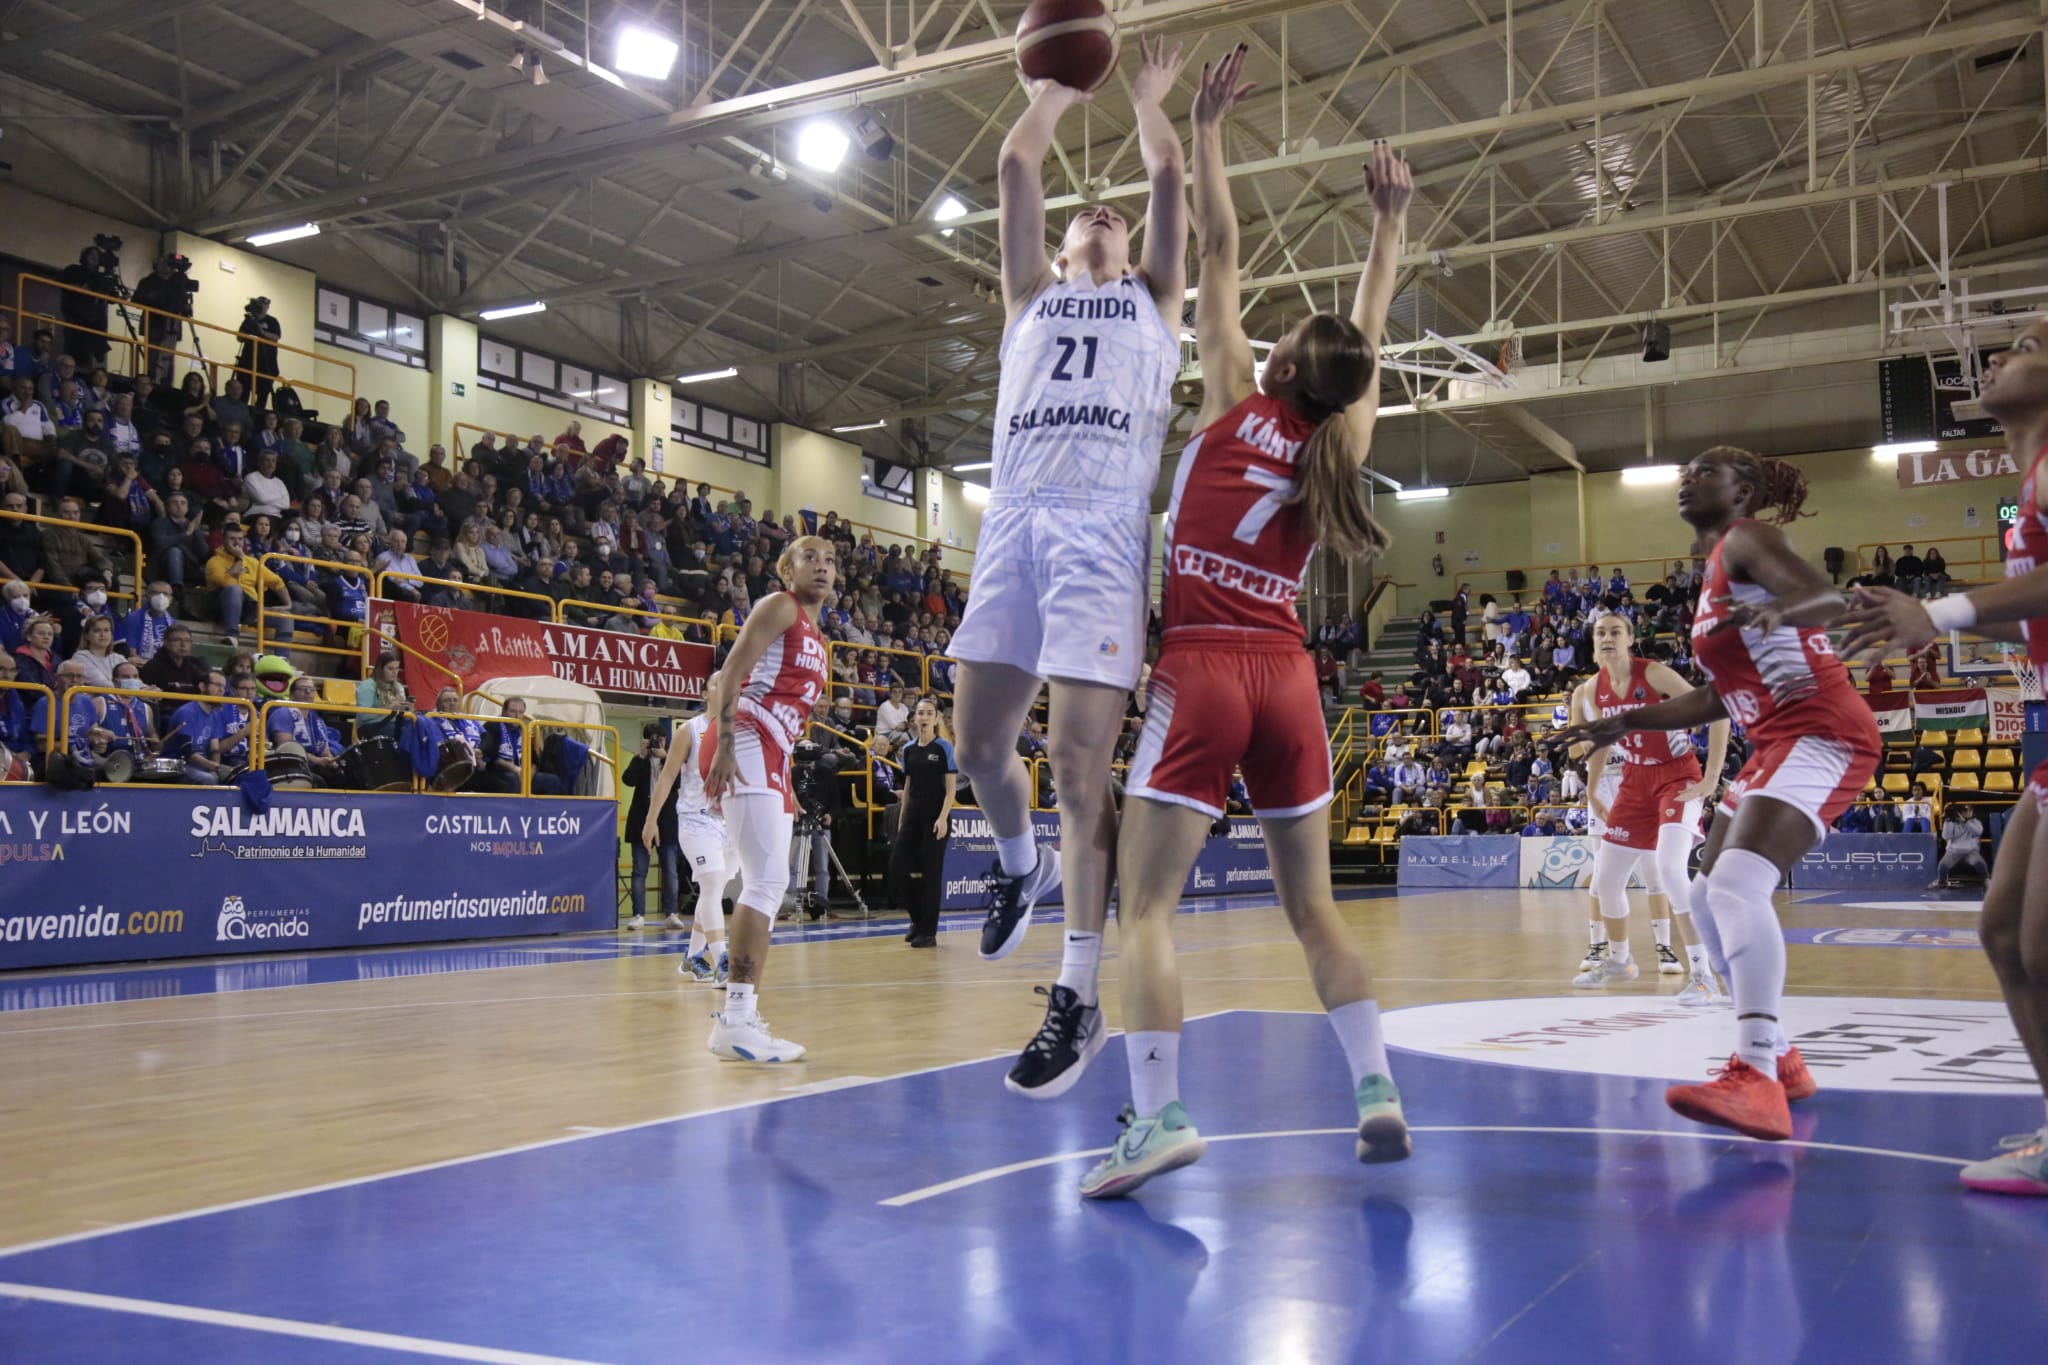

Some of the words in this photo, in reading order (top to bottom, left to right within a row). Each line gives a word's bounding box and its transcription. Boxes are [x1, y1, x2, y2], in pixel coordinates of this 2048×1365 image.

[1034, 297, 1137, 322] AVENIDA
[1050, 336, 1098, 381] 21
[1008, 405, 1131, 435] SALAMANCA
[1235, 412, 1304, 463] KÁNY
[1941, 428, 1966, 438] FALTAS
[1910, 452, 1960, 485] LA
[1965, 448, 2021, 478] GA
[1232, 464, 1298, 545] 7
[491, 627, 546, 659] Ranita
[542, 628, 682, 670] AMANCA
[582, 664, 604, 686] LA
[1935, 705, 1966, 715] MISKOLC
[1995, 718, 2027, 732] DIÓS
[28, 810, 49, 840] Y
[61, 802, 131, 834] LEÓN
[190, 805, 367, 838] SALAMANCA
[425, 814, 512, 835] CASTILLA
[520, 816, 532, 838] Y
[538, 810, 580, 835] LEÓN
[950, 818, 994, 838] SALAMA
[0, 843, 65, 866] PULSA
[238, 845, 290, 858] Patrimonio
[292, 845, 304, 857] de
[306, 845, 314, 857] la
[316, 844, 366, 857] Humanidad
[470, 841, 491, 852] NOS
[1802, 851, 1924, 864] custo
[1407, 854, 1510, 865] MAYBELLINE
[357, 889, 585, 930] perfumeriasavenida.com
[227, 916, 309, 939] avenida
